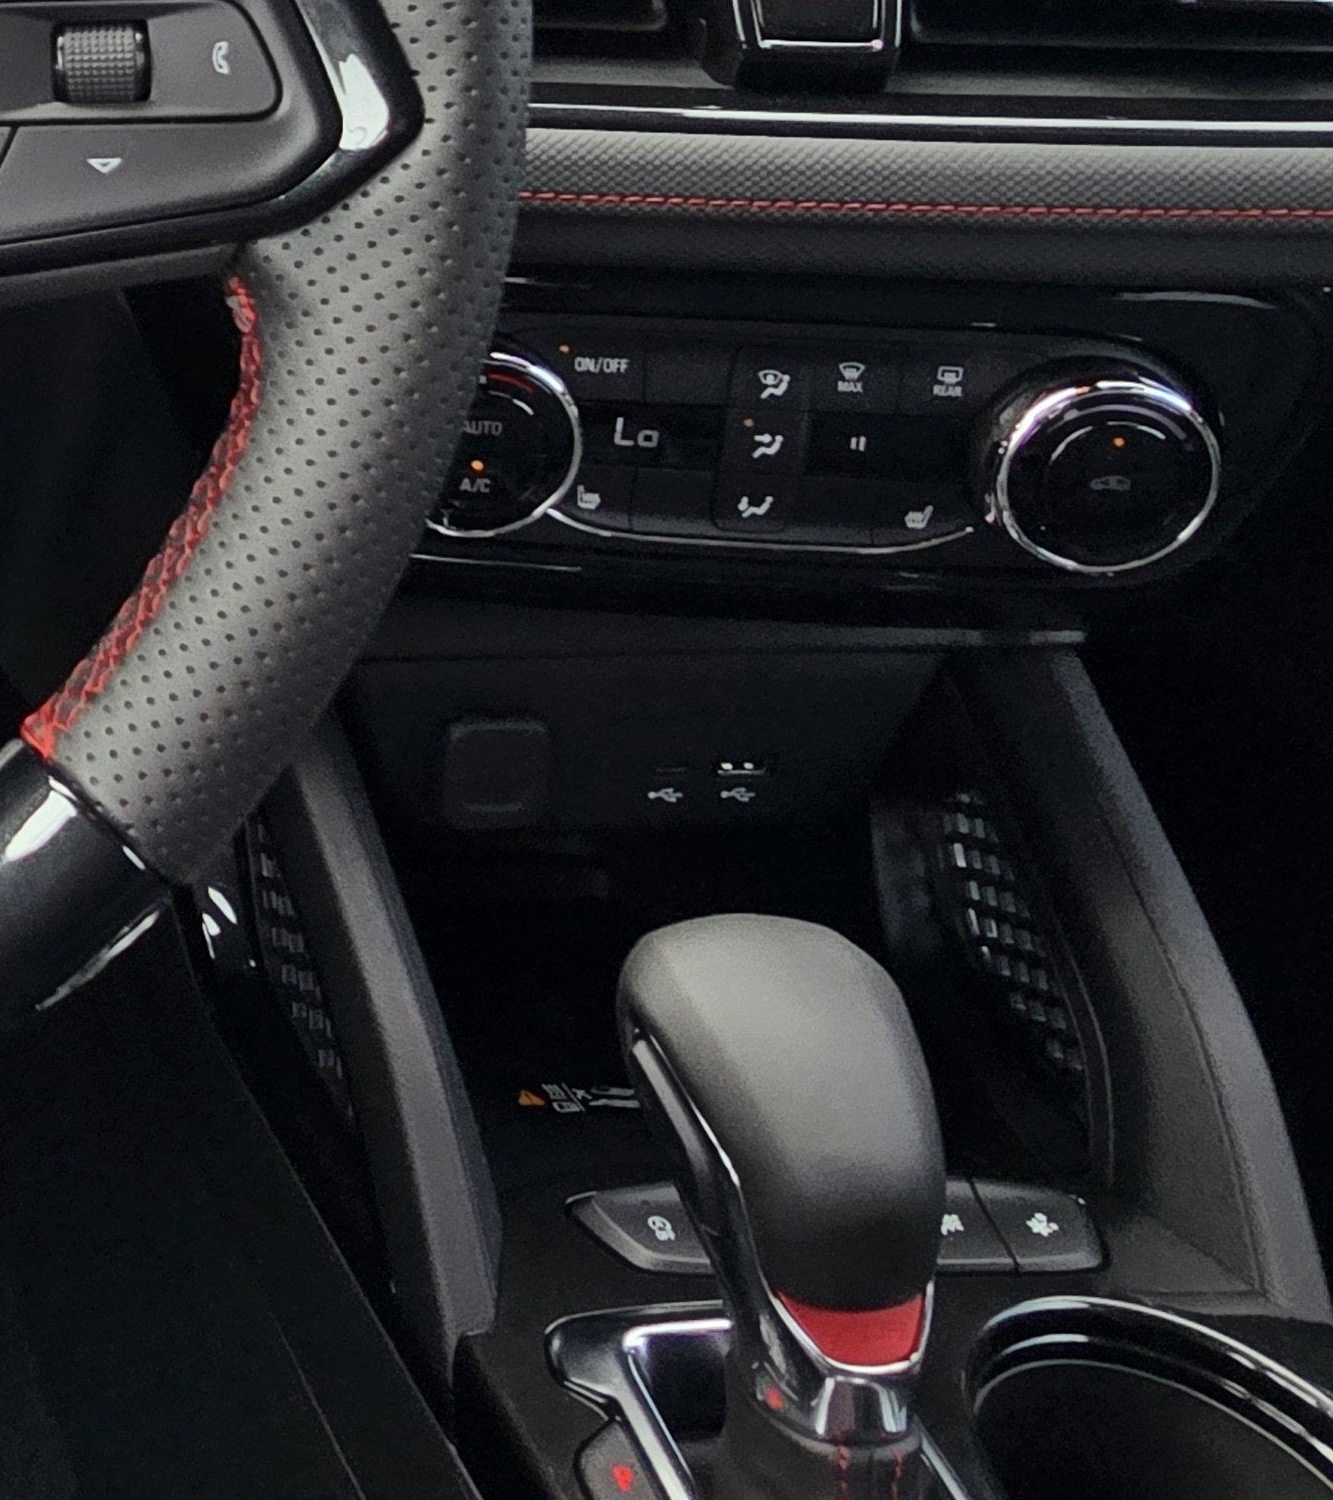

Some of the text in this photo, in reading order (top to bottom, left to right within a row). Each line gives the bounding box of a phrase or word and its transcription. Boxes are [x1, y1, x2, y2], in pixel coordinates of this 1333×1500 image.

[574, 357, 630, 375] ON/OFF
[837, 380, 864, 393] MAX
[933, 384, 964, 397] REAR
[459, 477, 491, 493] A/C
